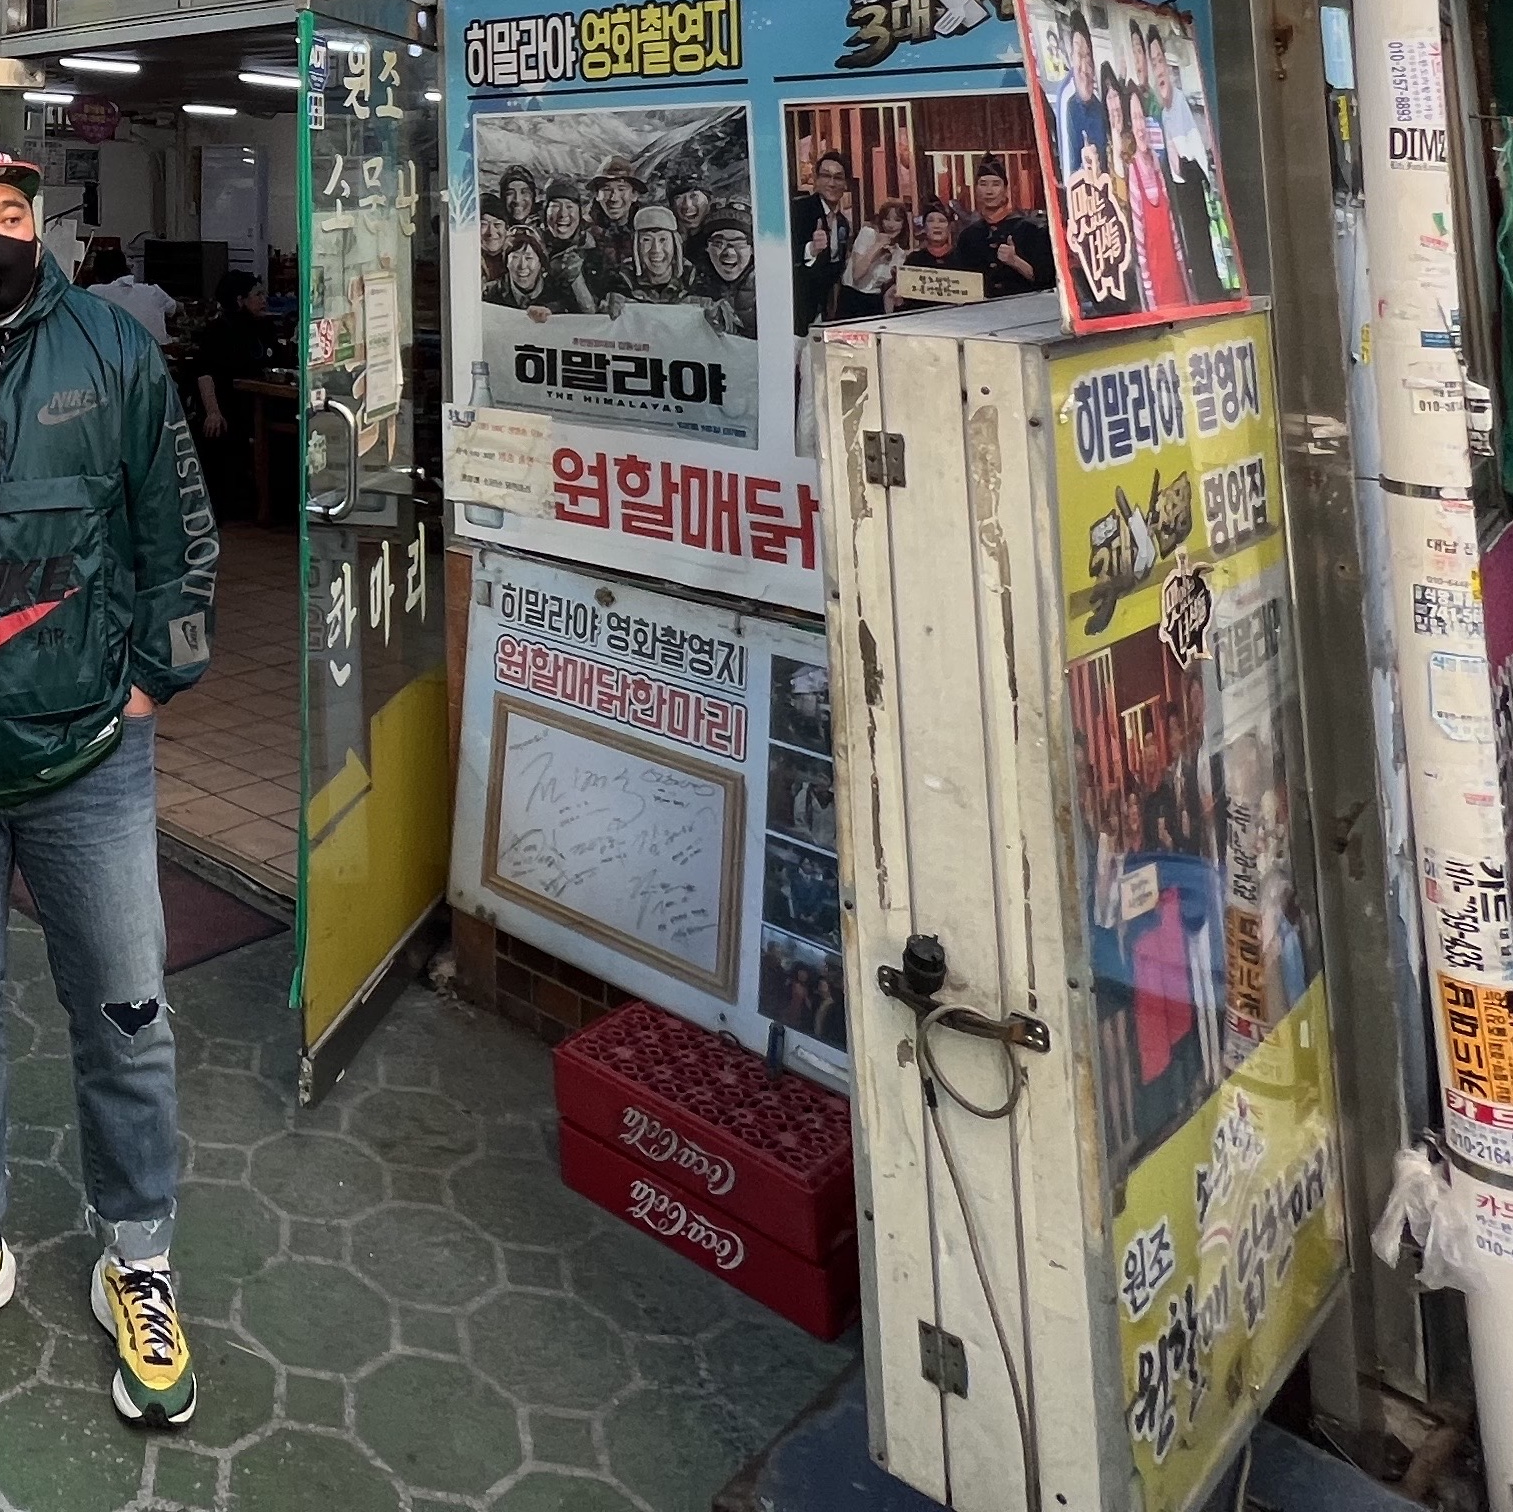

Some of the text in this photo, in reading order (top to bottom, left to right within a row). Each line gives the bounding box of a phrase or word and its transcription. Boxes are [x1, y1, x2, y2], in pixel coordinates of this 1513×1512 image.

[343, 37, 404, 120] 원조
[465, 16, 579, 85] 히말라야
[321, 153, 419, 236] 소문난
[48, 389, 97, 410] NIKE
[515, 341, 727, 406] 히말라야
[546, 390, 685, 413] THE HIMALAYAS
[1074, 360, 1186, 465] 히말라야
[164, 418, 220, 607] JUST DO IT
[551, 446, 821, 571] 원할매닭
[501, 584, 749, 689] 히말라야 영화촬영지
[496, 635, 749, 763] 원할매닭한마리
[1442, 980, 1488, 1099] 카드대납
[618, 1106, 736, 1196] Coca-Cola
[625, 1179, 746, 1270] Coca-Cola
[1123, 1220, 1175, 1317] 원조
